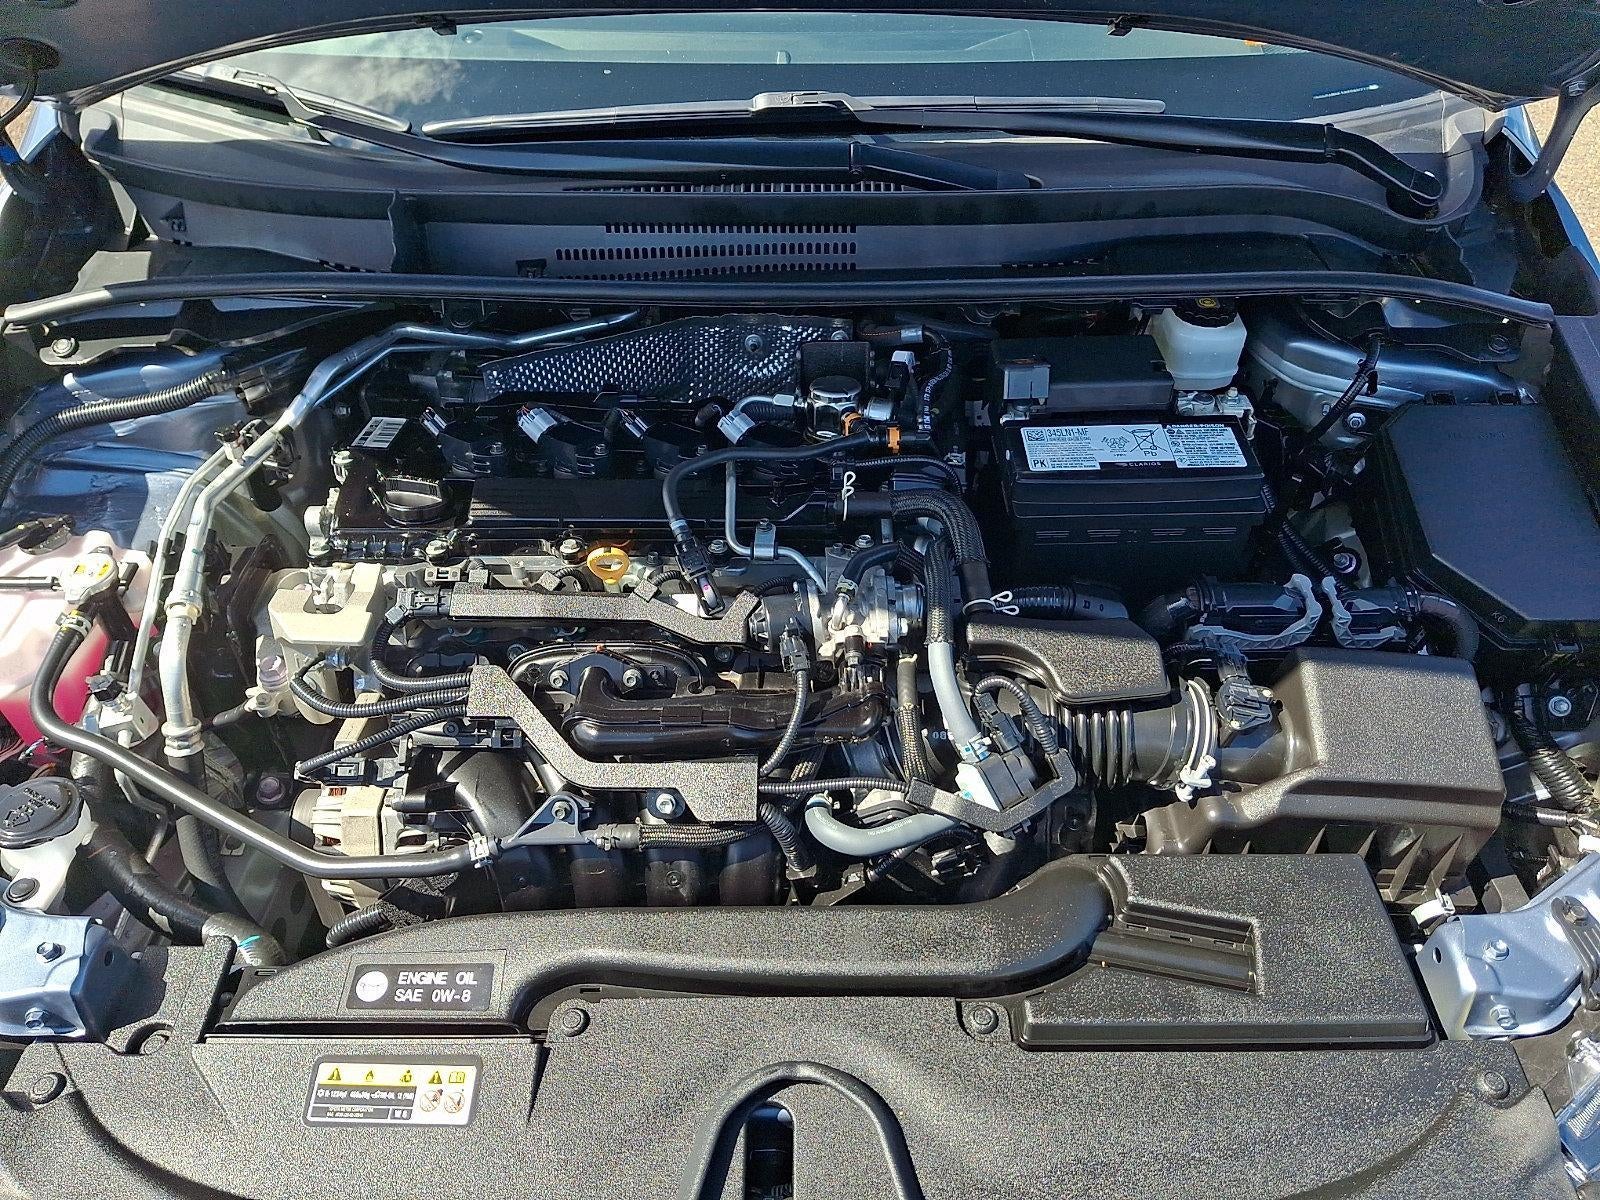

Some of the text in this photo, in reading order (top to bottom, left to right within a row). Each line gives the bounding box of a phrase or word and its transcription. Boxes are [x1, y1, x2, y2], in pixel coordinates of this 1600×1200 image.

[1032, 459, 1047, 468] PK
[397, 971, 478, 985] ENGINE OIL
[394, 988, 424, 1002] SAE
